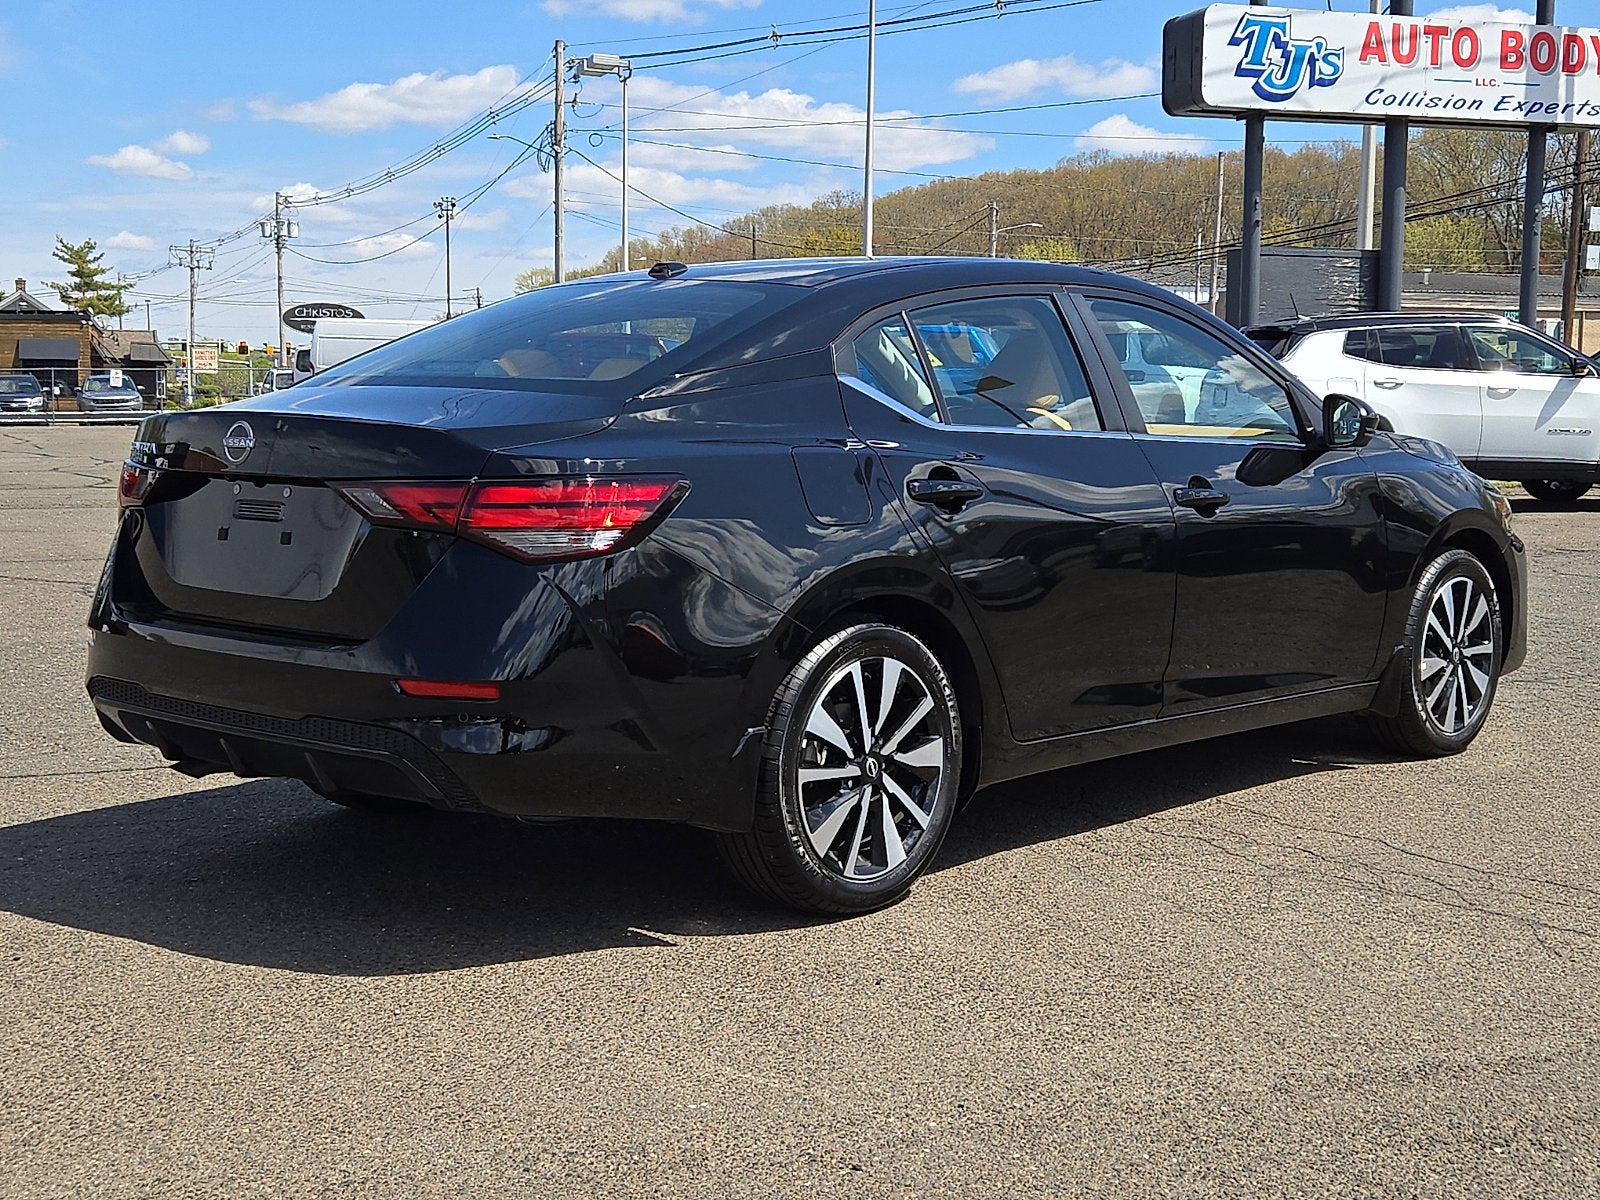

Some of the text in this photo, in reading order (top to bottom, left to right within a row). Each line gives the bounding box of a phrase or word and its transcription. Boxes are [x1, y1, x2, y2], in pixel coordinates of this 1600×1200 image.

[1358, 21, 1480, 69] AUTO
[1227, 12, 1344, 102] TJ's
[1474, 77, 1501, 88] LLC.
[1364, 88, 1600, 118] Collision Experts
[294, 307, 354, 318] CHRISTOS
[223, 438, 254, 449] SSAN
